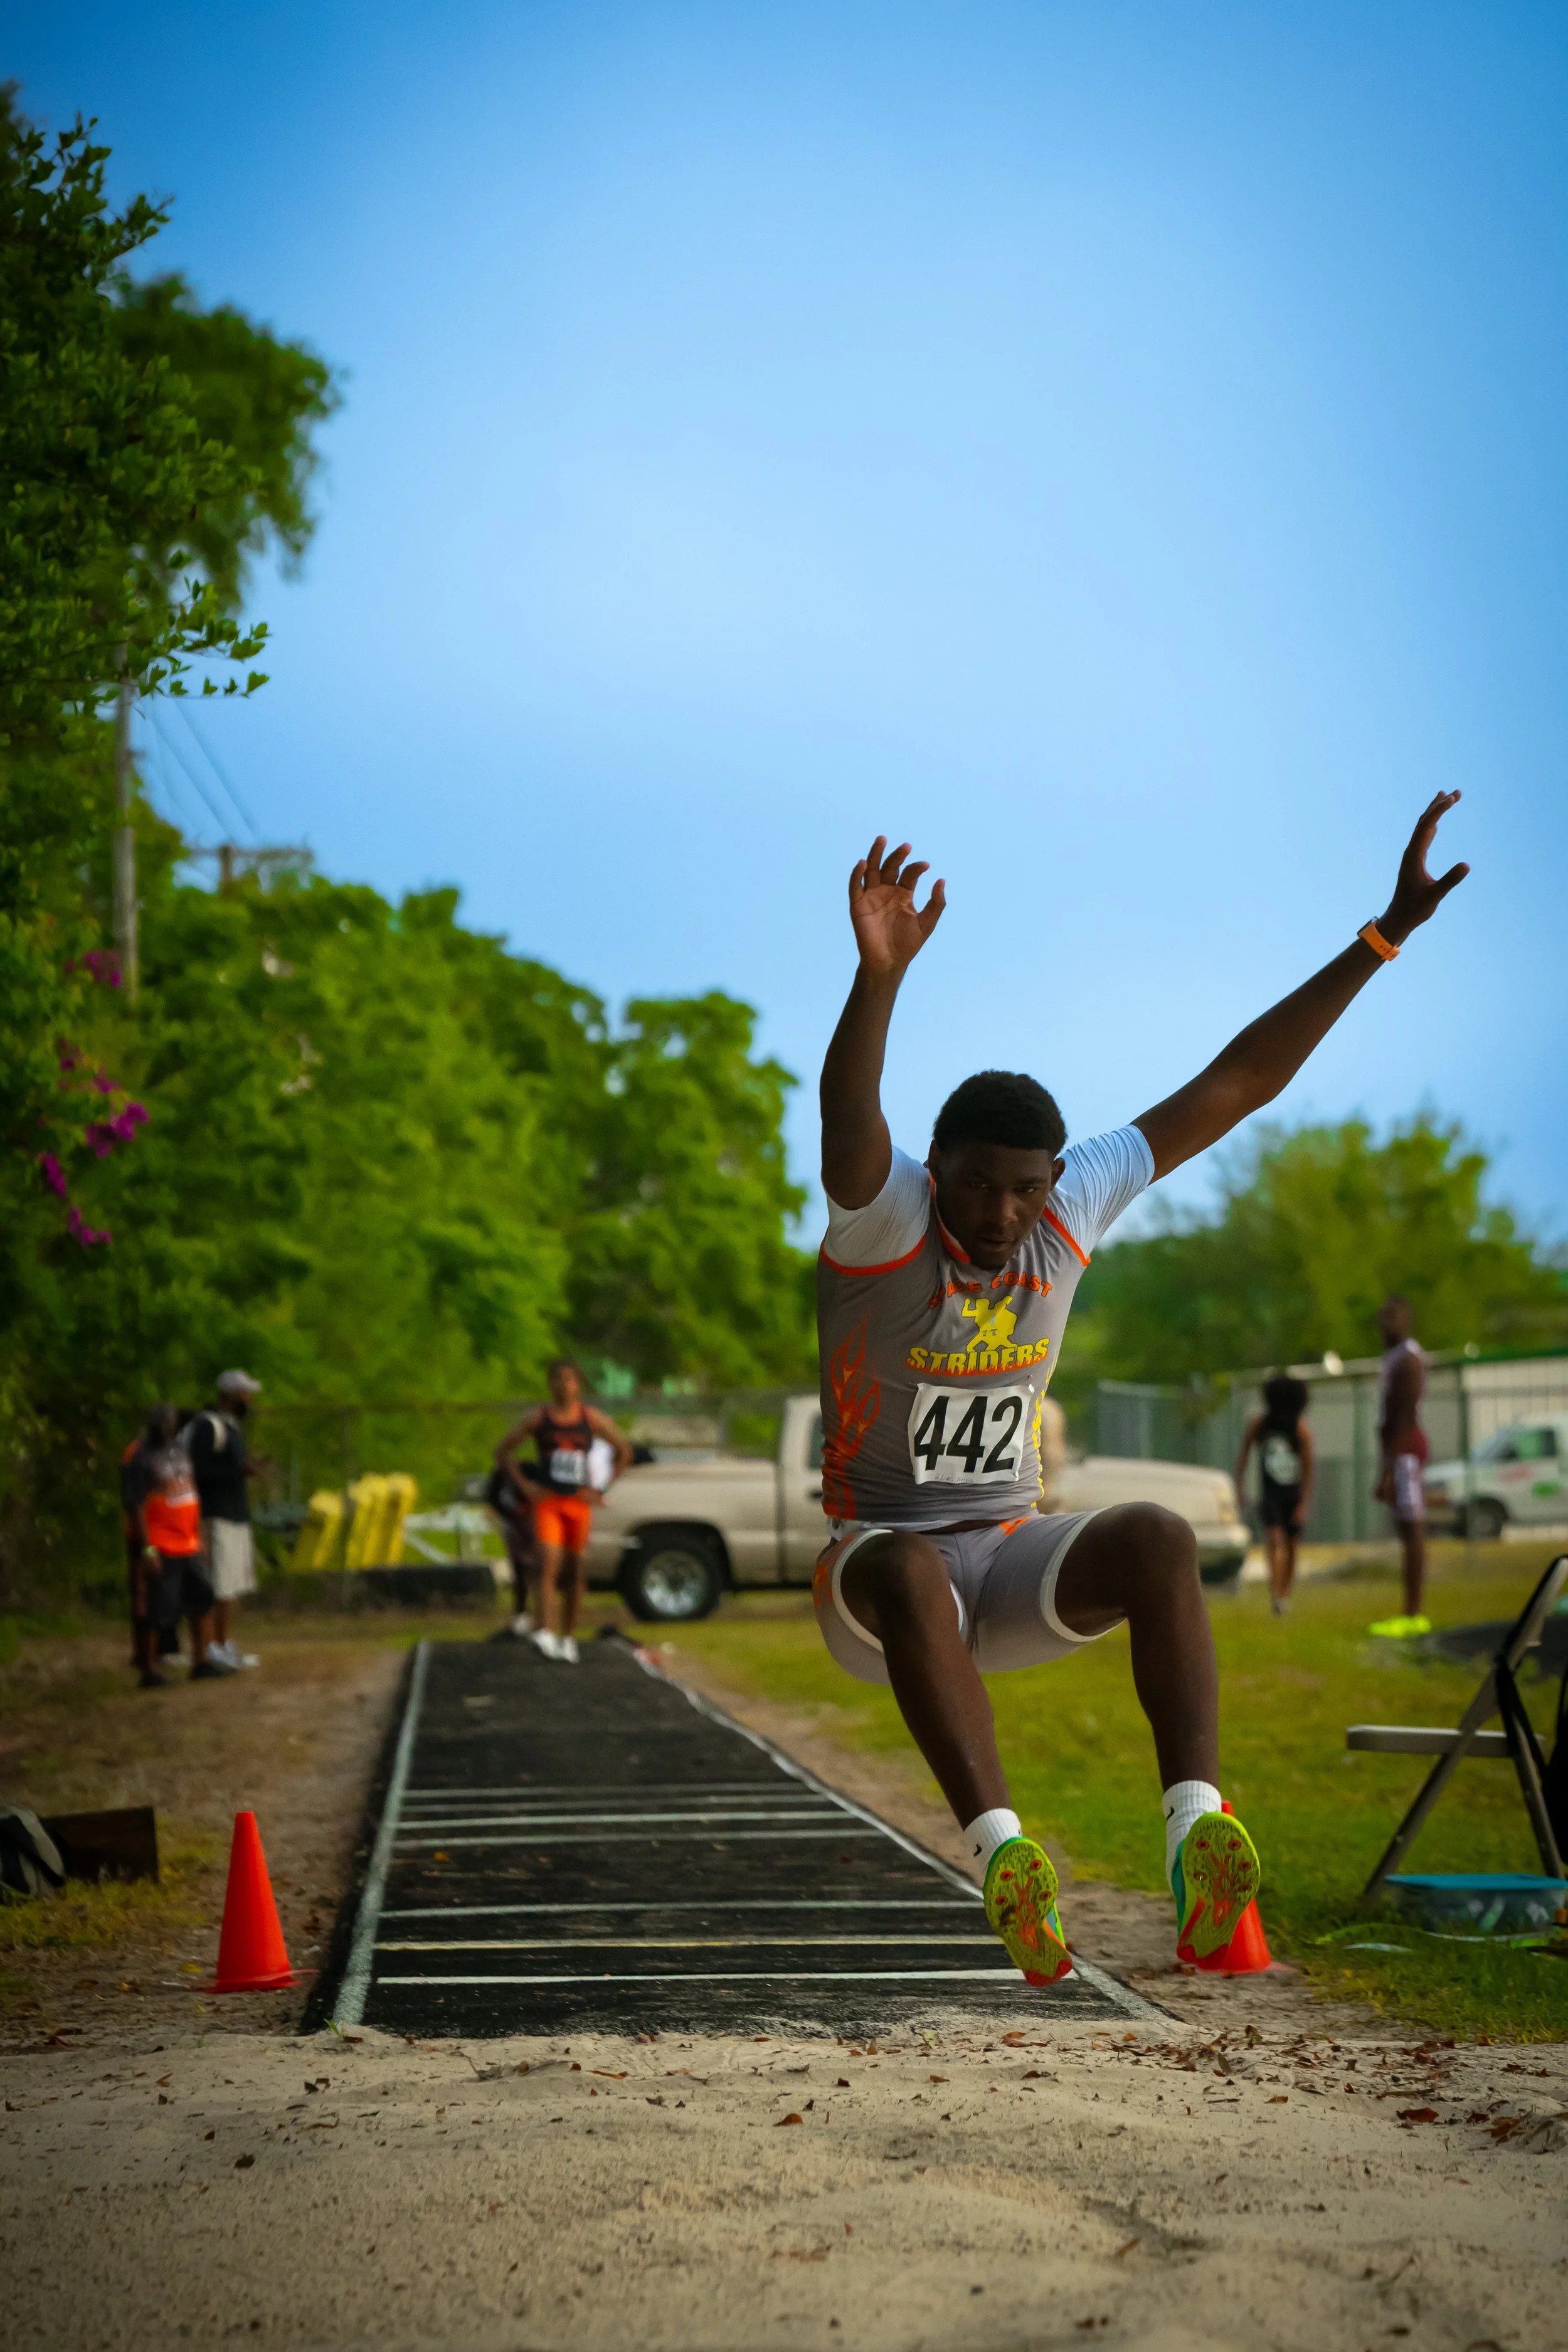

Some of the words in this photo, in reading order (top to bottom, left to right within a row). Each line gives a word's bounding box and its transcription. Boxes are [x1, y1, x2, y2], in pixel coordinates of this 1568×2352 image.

[990, 1271, 1052, 1298] COAST
[906, 1337, 1050, 1375] STRIDERS
[914, 1396, 1022, 1473] 442
